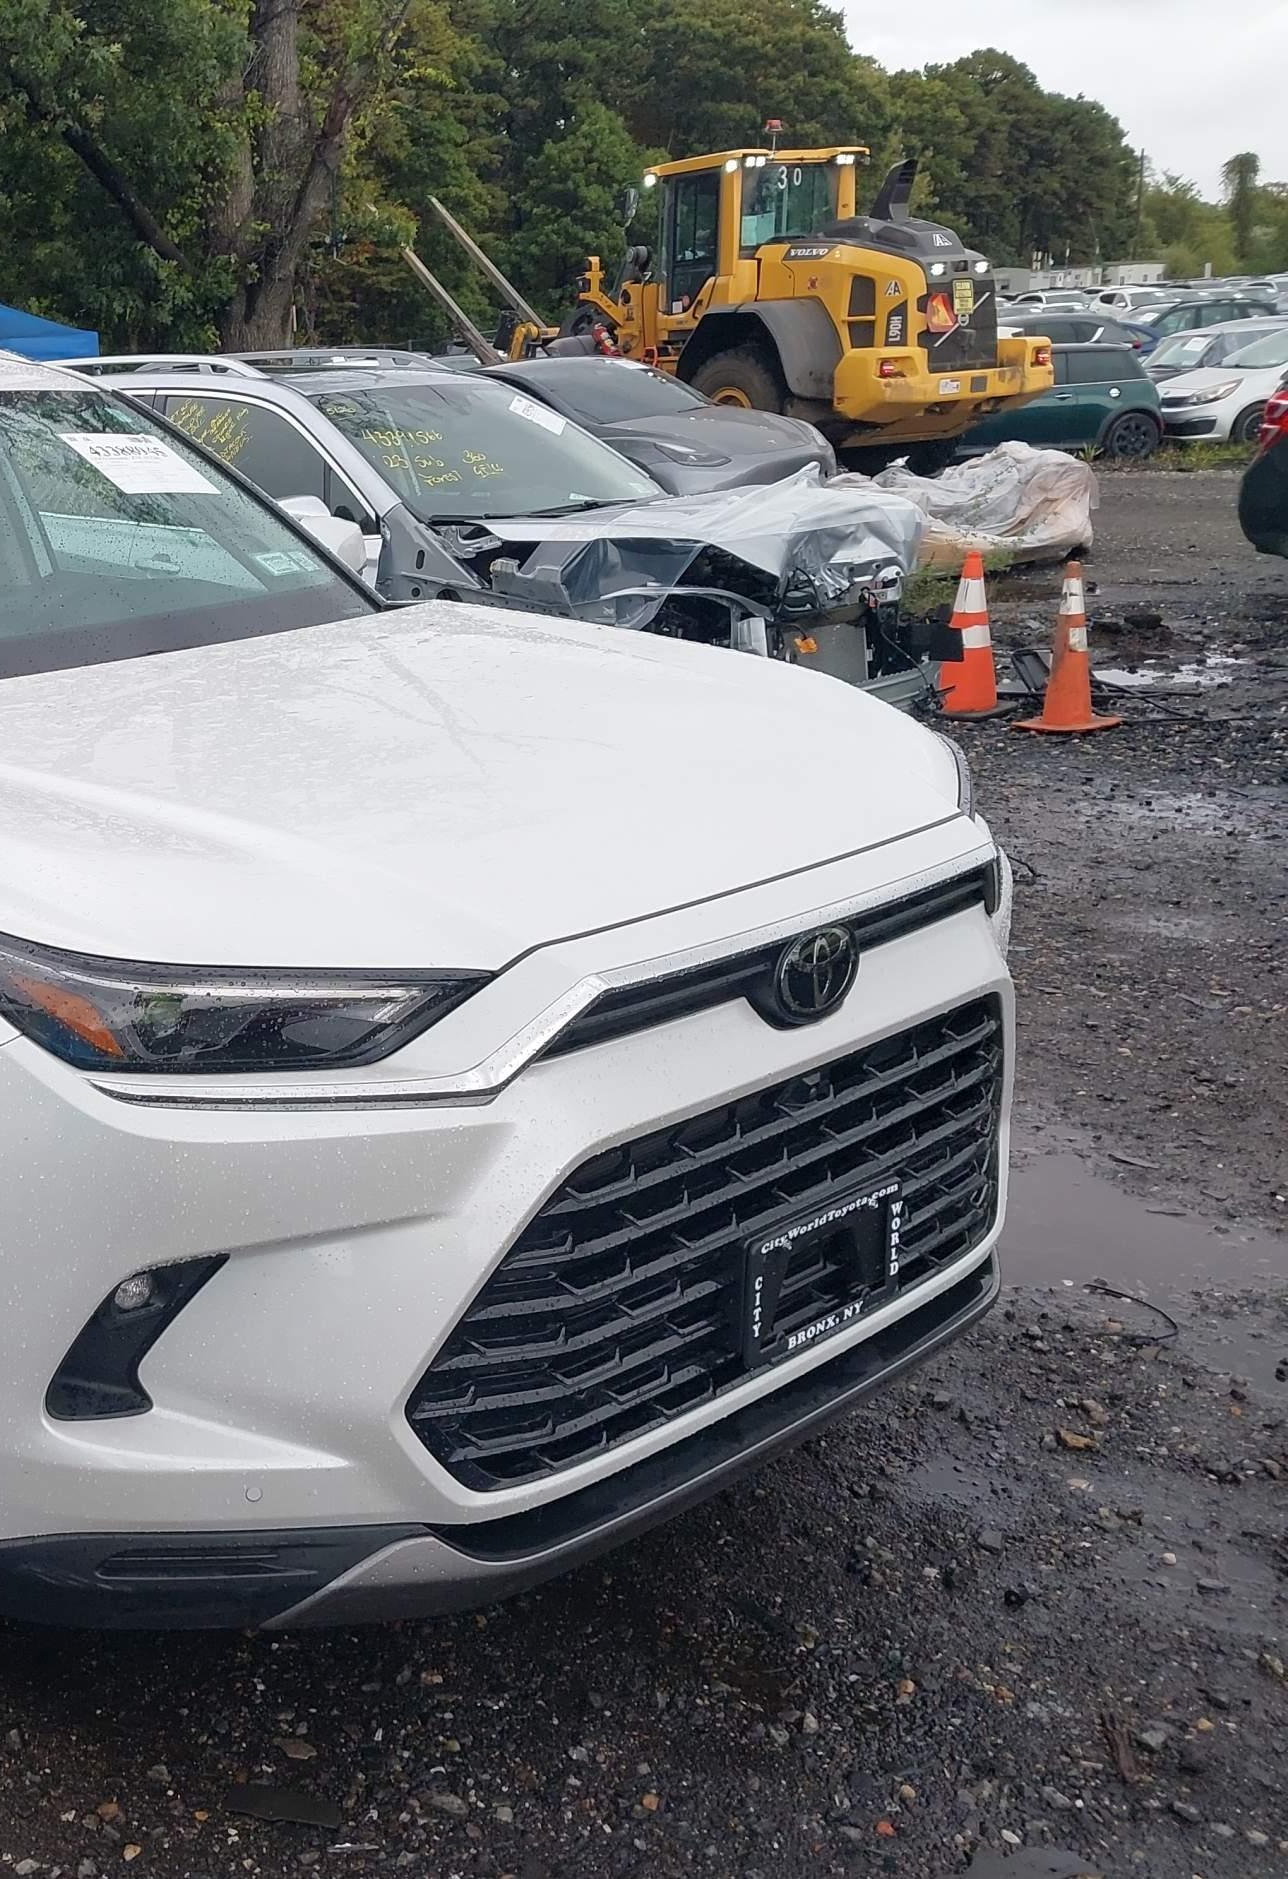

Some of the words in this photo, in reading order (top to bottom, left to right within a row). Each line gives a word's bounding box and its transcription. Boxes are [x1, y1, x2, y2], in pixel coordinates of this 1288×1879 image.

[790, 248, 829, 256] VOLVO
[888, 315, 903, 342] L90H
[889, 1201, 903, 1276] WORLD
[752, 1277, 763, 1338] CITY
[787, 1315, 840, 1349] BRONX,
[842, 1301, 864, 1320] NY
